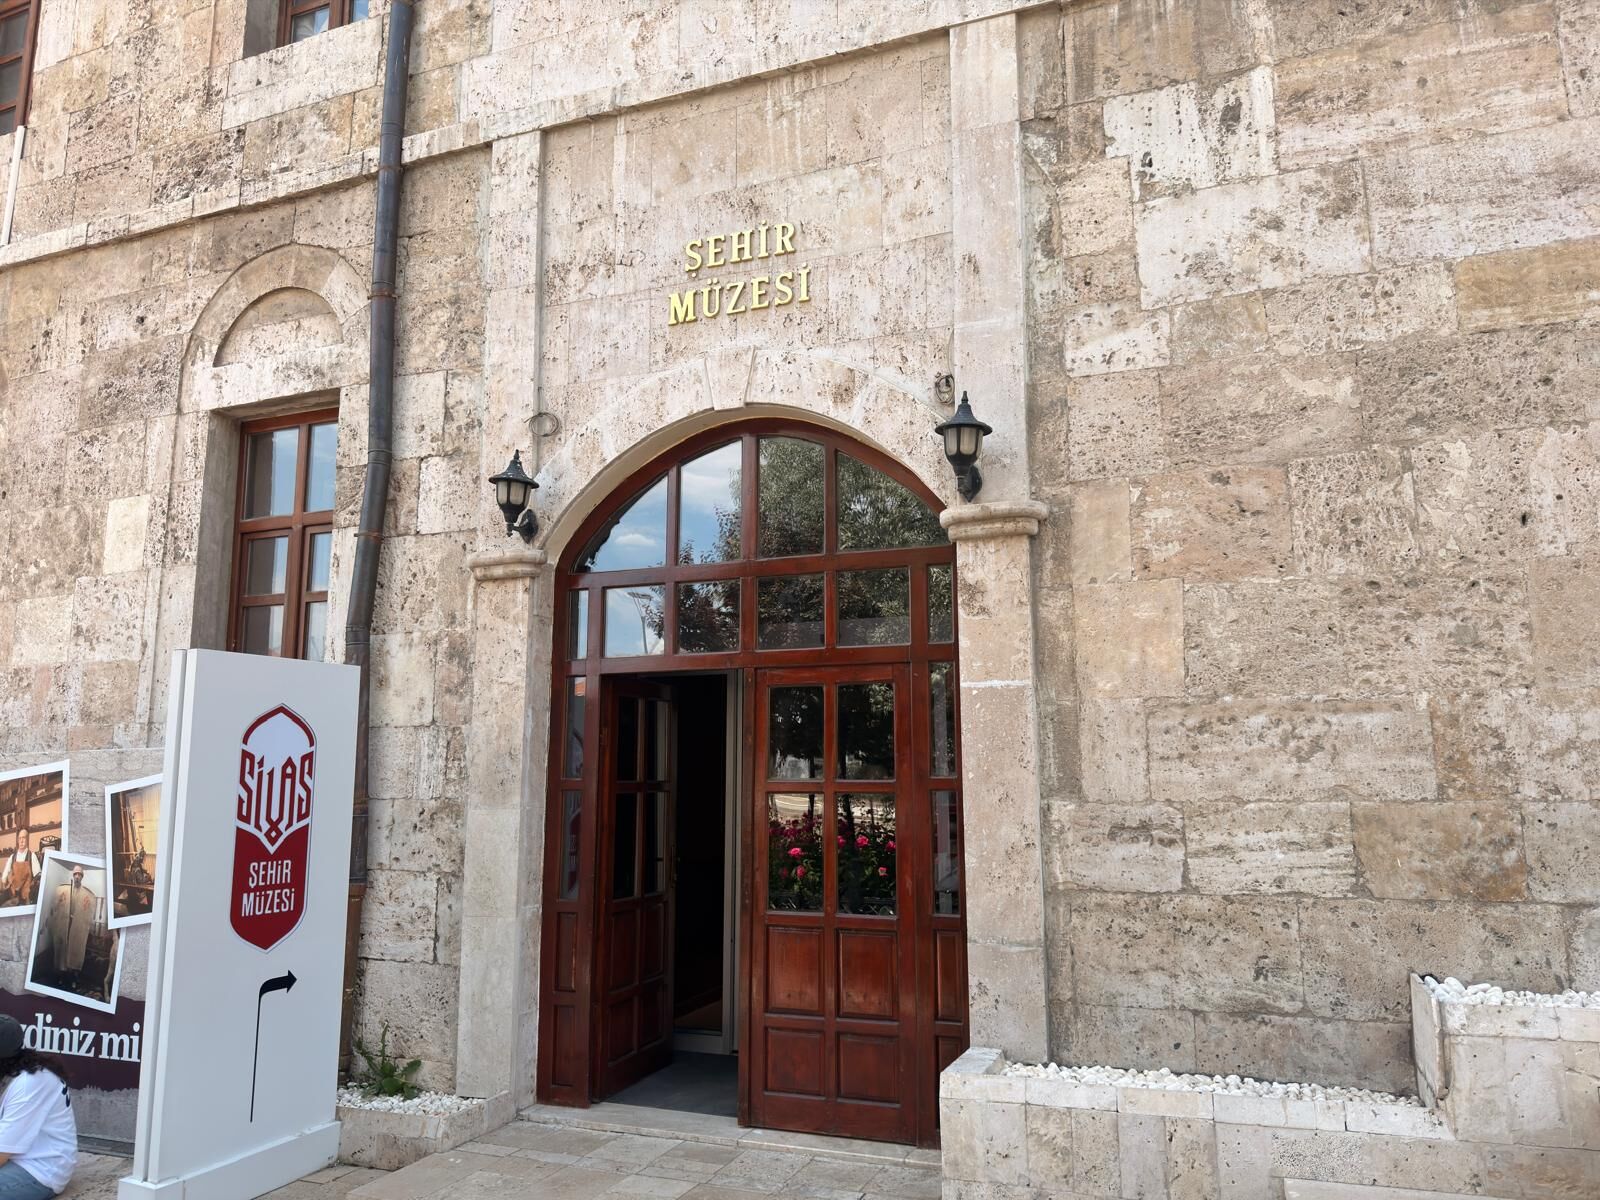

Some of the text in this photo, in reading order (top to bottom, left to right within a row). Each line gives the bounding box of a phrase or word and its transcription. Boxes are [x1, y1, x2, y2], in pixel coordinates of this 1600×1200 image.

[684, 219, 797, 279] ŞEHİR
[667, 262, 812, 326] MÜZESİ
[248, 859, 292, 889] ŞEHİR
[241, 888, 296, 918] MÜZESİ
[98, 1021, 141, 1063] mi
